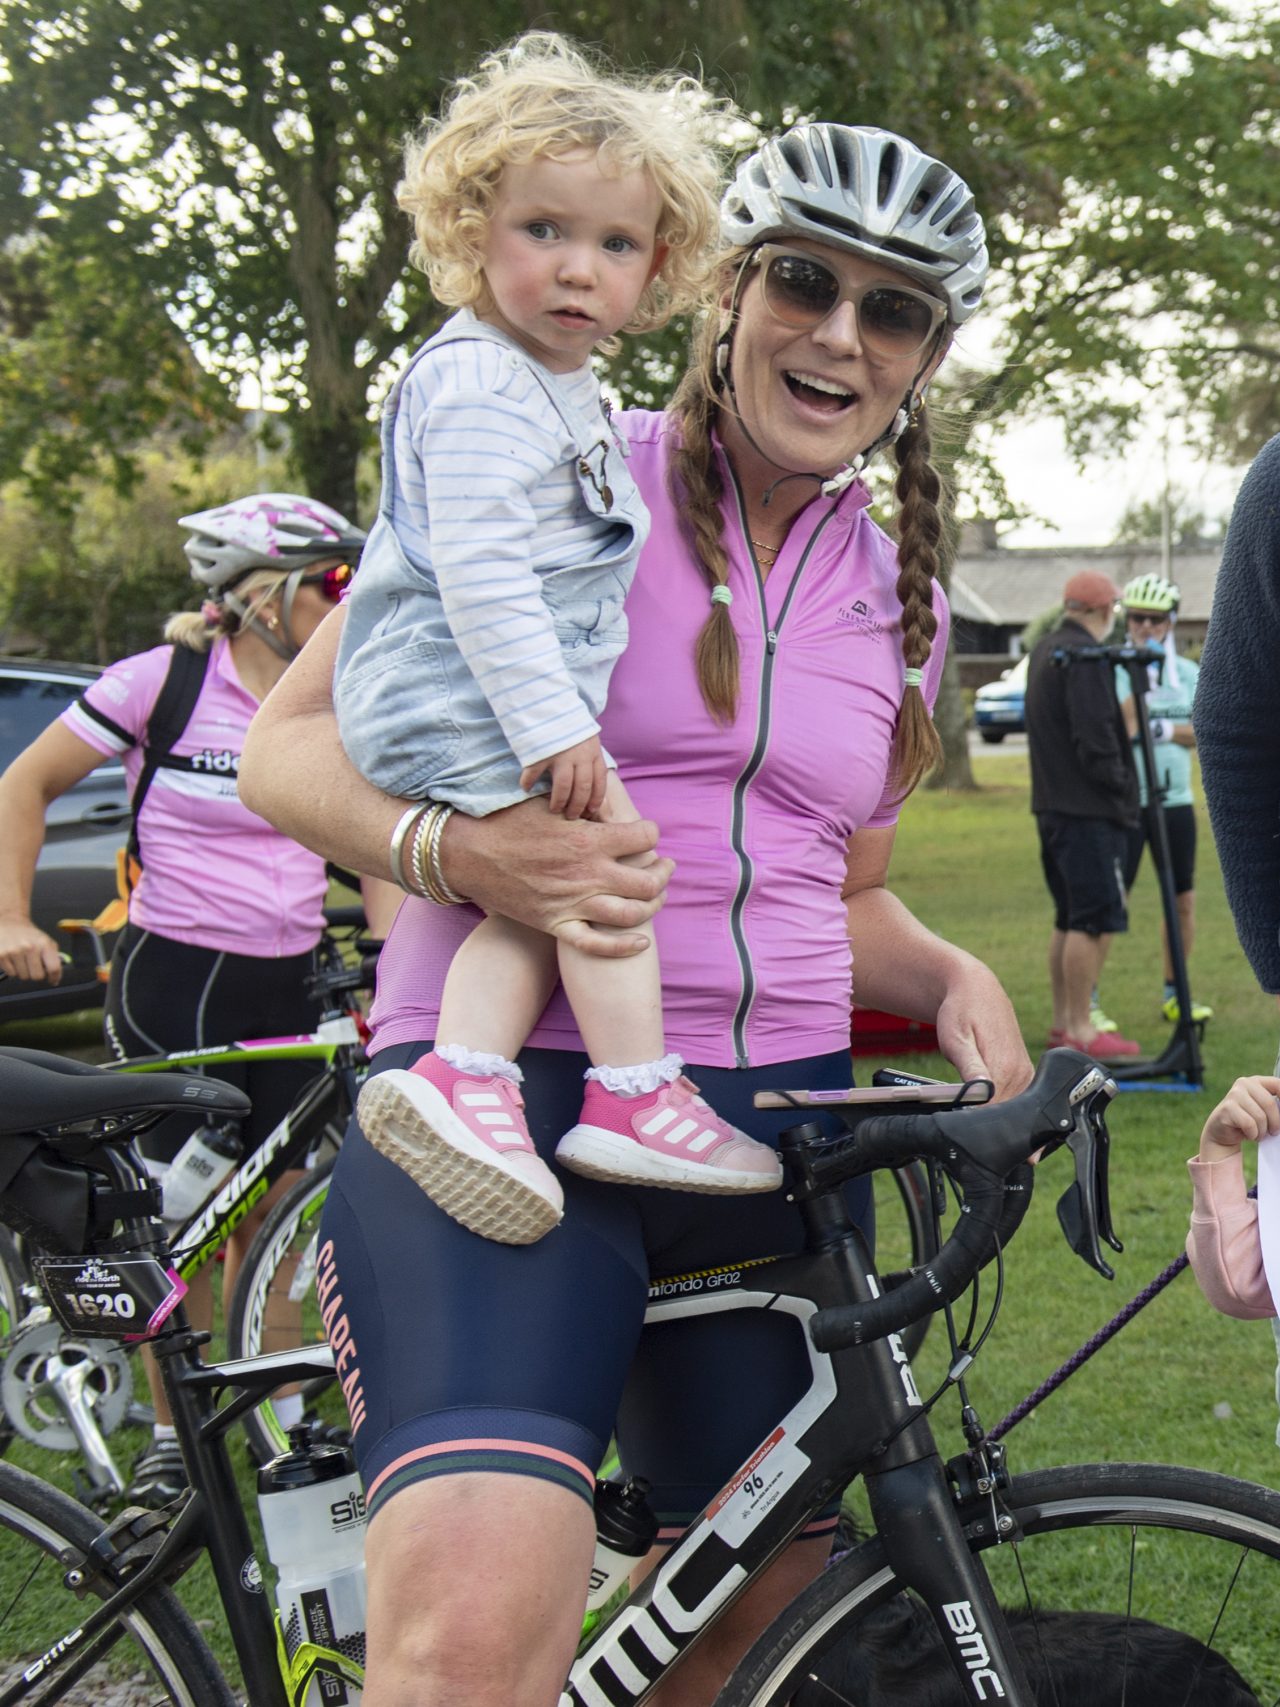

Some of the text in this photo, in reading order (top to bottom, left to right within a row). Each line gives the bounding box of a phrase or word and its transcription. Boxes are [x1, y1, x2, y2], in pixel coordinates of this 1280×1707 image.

[706, 1271, 740, 1288] GF02
[65, 1292, 136, 1319] 1620
[743, 1473, 764, 1498] 96
[941, 1600, 1005, 1701] BMC
